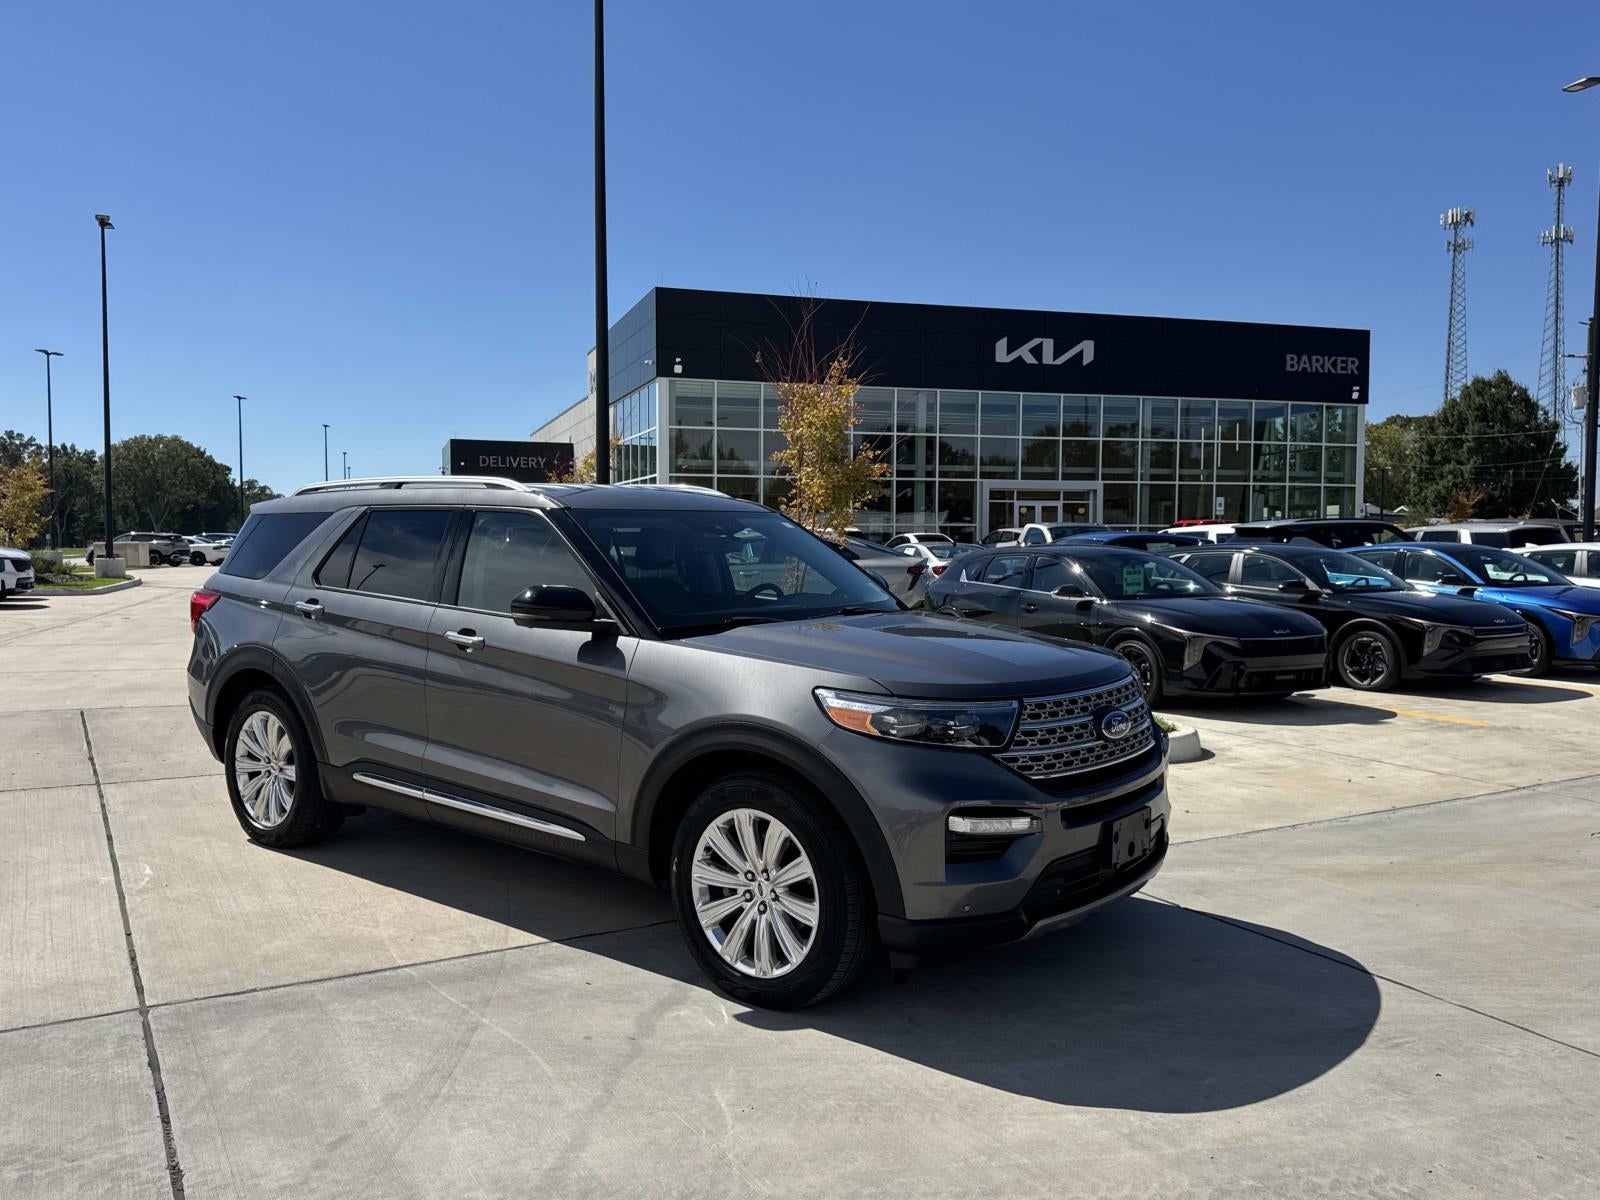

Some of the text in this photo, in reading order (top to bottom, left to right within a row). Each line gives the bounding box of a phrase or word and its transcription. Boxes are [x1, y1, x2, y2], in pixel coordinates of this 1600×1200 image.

[995, 336, 1095, 367] KIA
[1285, 354, 1359, 375] BARKER
[479, 455, 547, 468] DELIVERY
